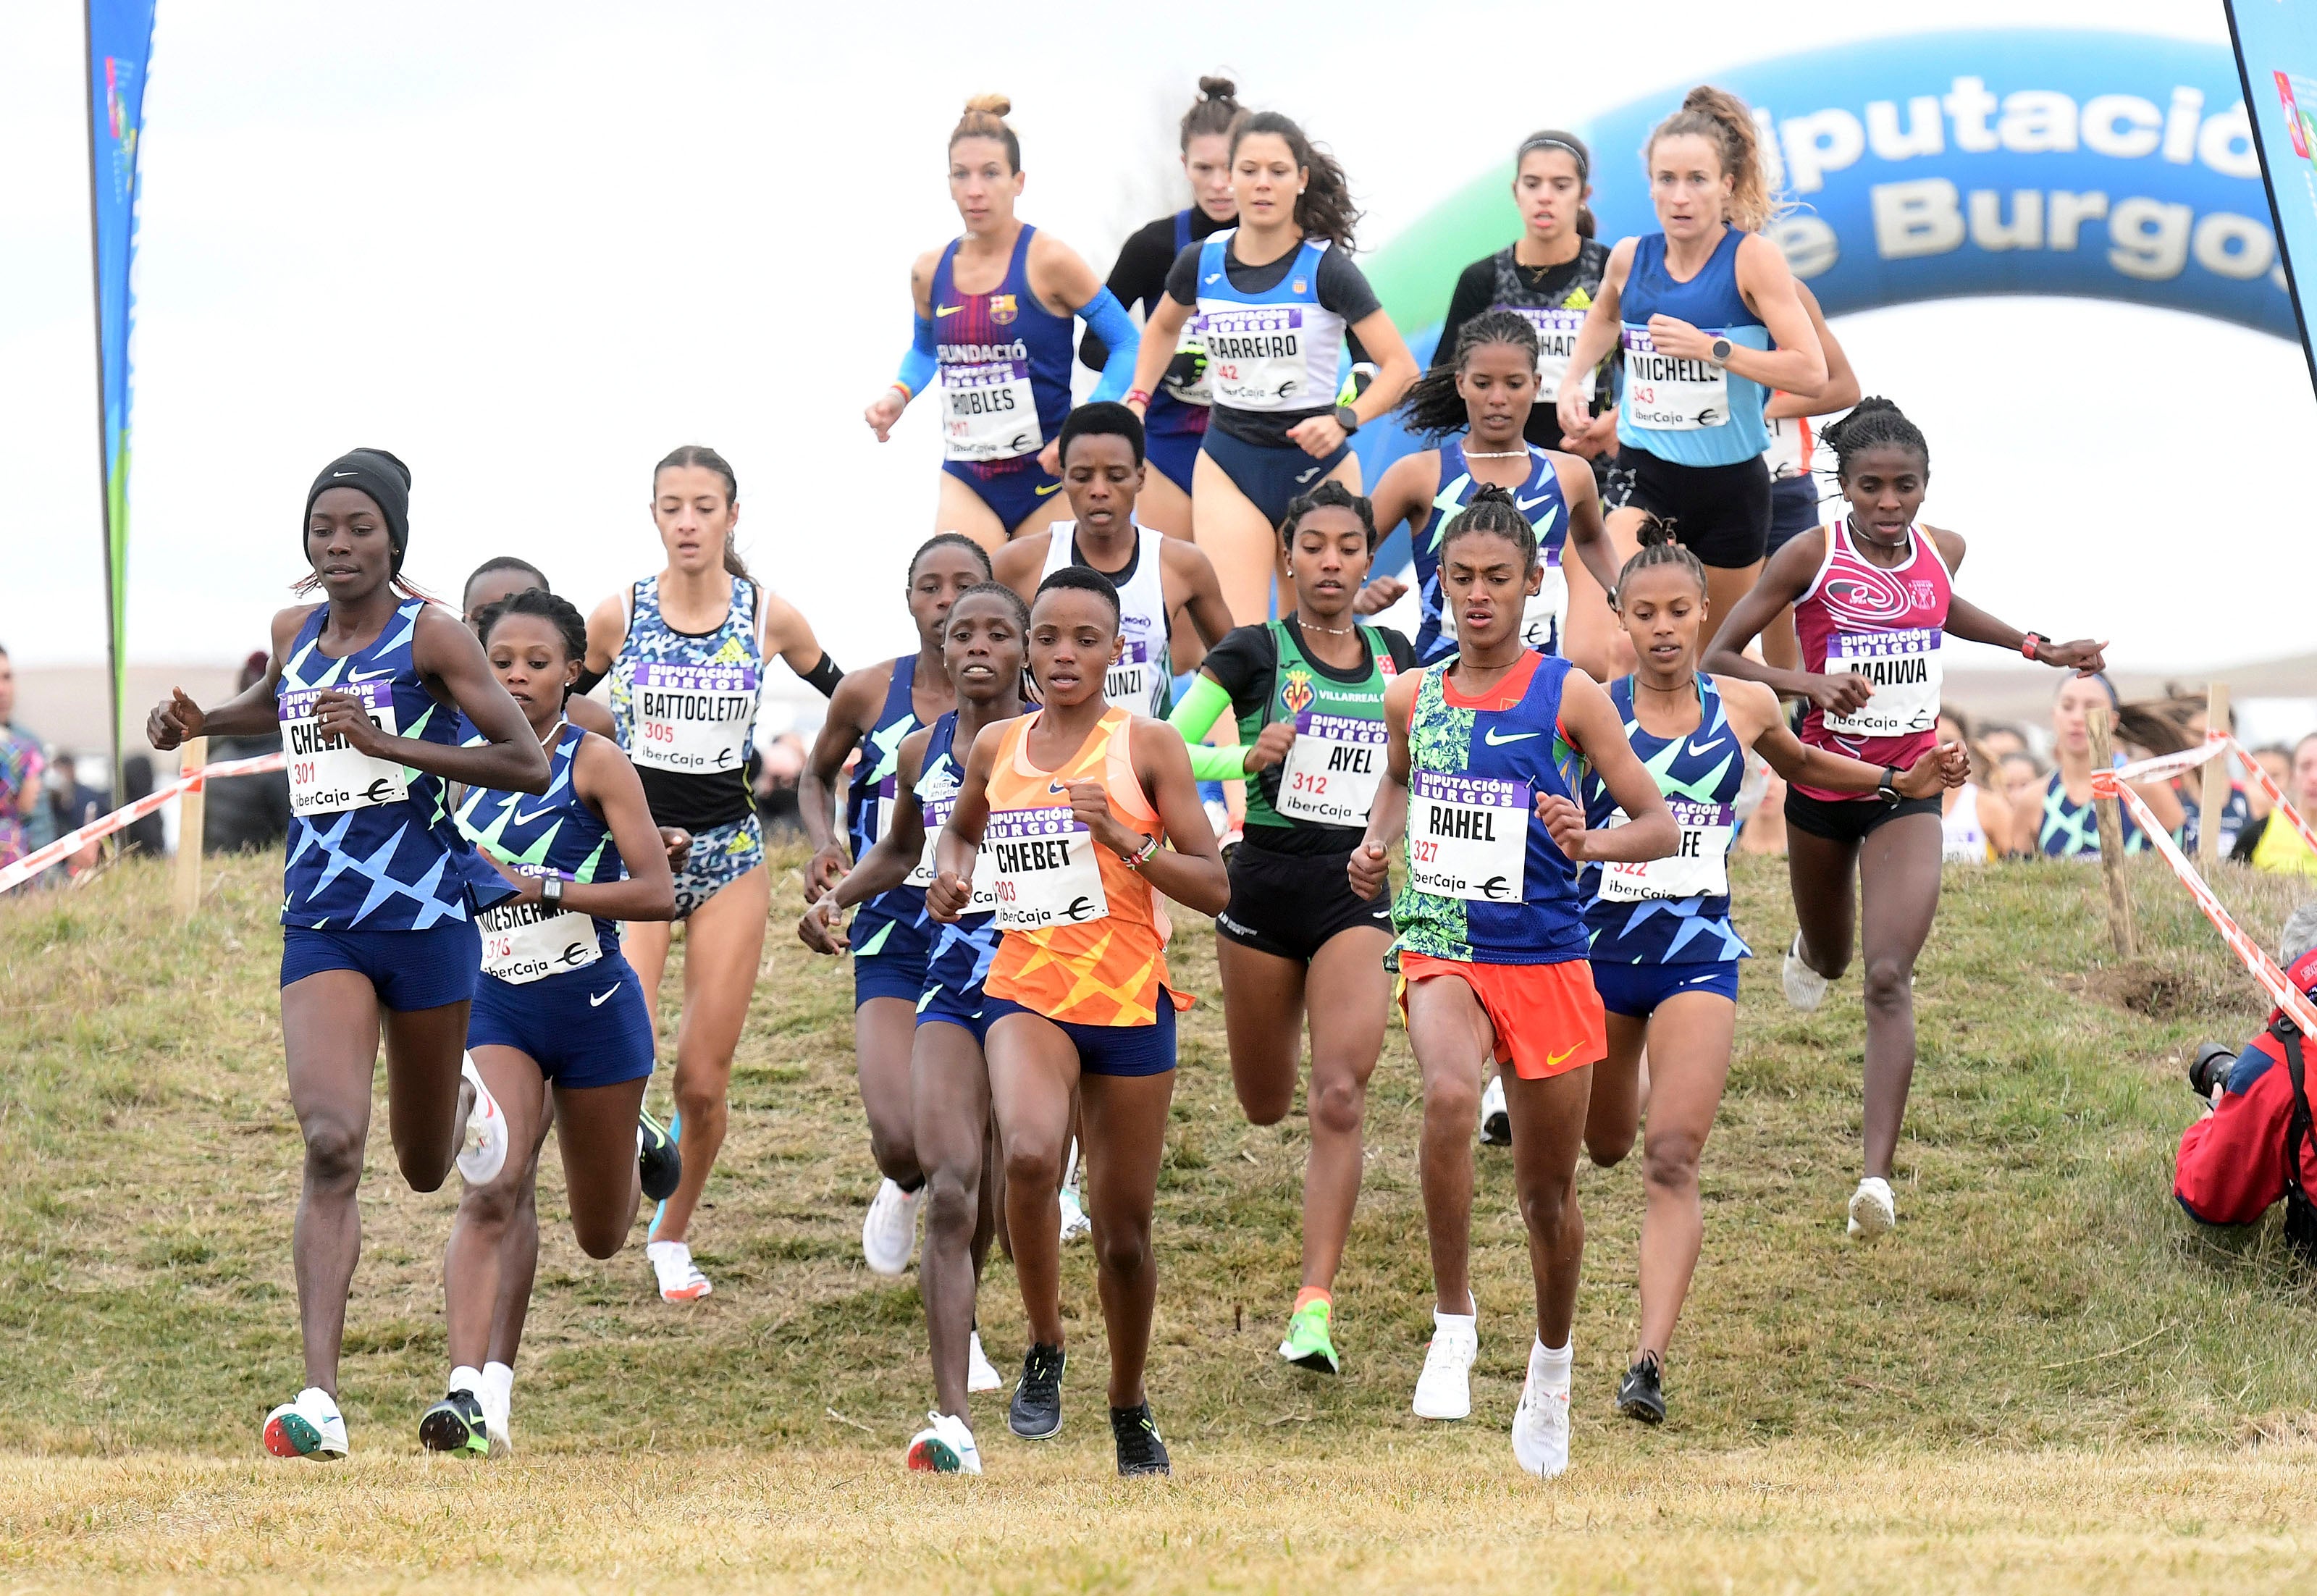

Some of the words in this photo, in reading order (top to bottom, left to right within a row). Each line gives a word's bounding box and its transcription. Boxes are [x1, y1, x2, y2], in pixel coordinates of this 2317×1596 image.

[1752, 75, 2263, 194] iputació
[1762, 214, 1840, 280] e
[1208, 335, 1297, 359] BARREIRO
[1841, 629, 1931, 647] DIPUTACIÓN
[1841, 639, 1932, 658] BURGOS
[647, 674, 745, 691] BURGOS
[648, 663, 744, 680] DIPUTACIÓN
[1319, 689, 1379, 702] VILLARREAL
[287, 697, 376, 719] BUS
[644, 692, 749, 722] BATTOCLETTI
[644, 721, 673, 743] 305
[1308, 725, 1386, 743] BURGO
[642, 744, 704, 768] iberCaja
[1328, 746, 1372, 773] AYEL
[294, 761, 315, 786] 301
[1292, 772, 1327, 794] 312
[1421, 772, 1514, 794] DIPUTACIÓN
[295, 788, 350, 807] iberCaja
[1421, 785, 1513, 807] BURGOS
[989, 807, 1074, 826] DIPUTACIÓN
[1287, 796, 1352, 820] iberCaja
[989, 819, 1075, 838] BURGOS
[1429, 805, 1496, 841] RAHEL
[996, 840, 1070, 874] CHEBET
[1413, 839, 1438, 862] 327
[1413, 868, 1466, 892] iberCaja
[995, 881, 1016, 902] 303
[999, 908, 1051, 927] iberCaja
[487, 938, 511, 959] 316
